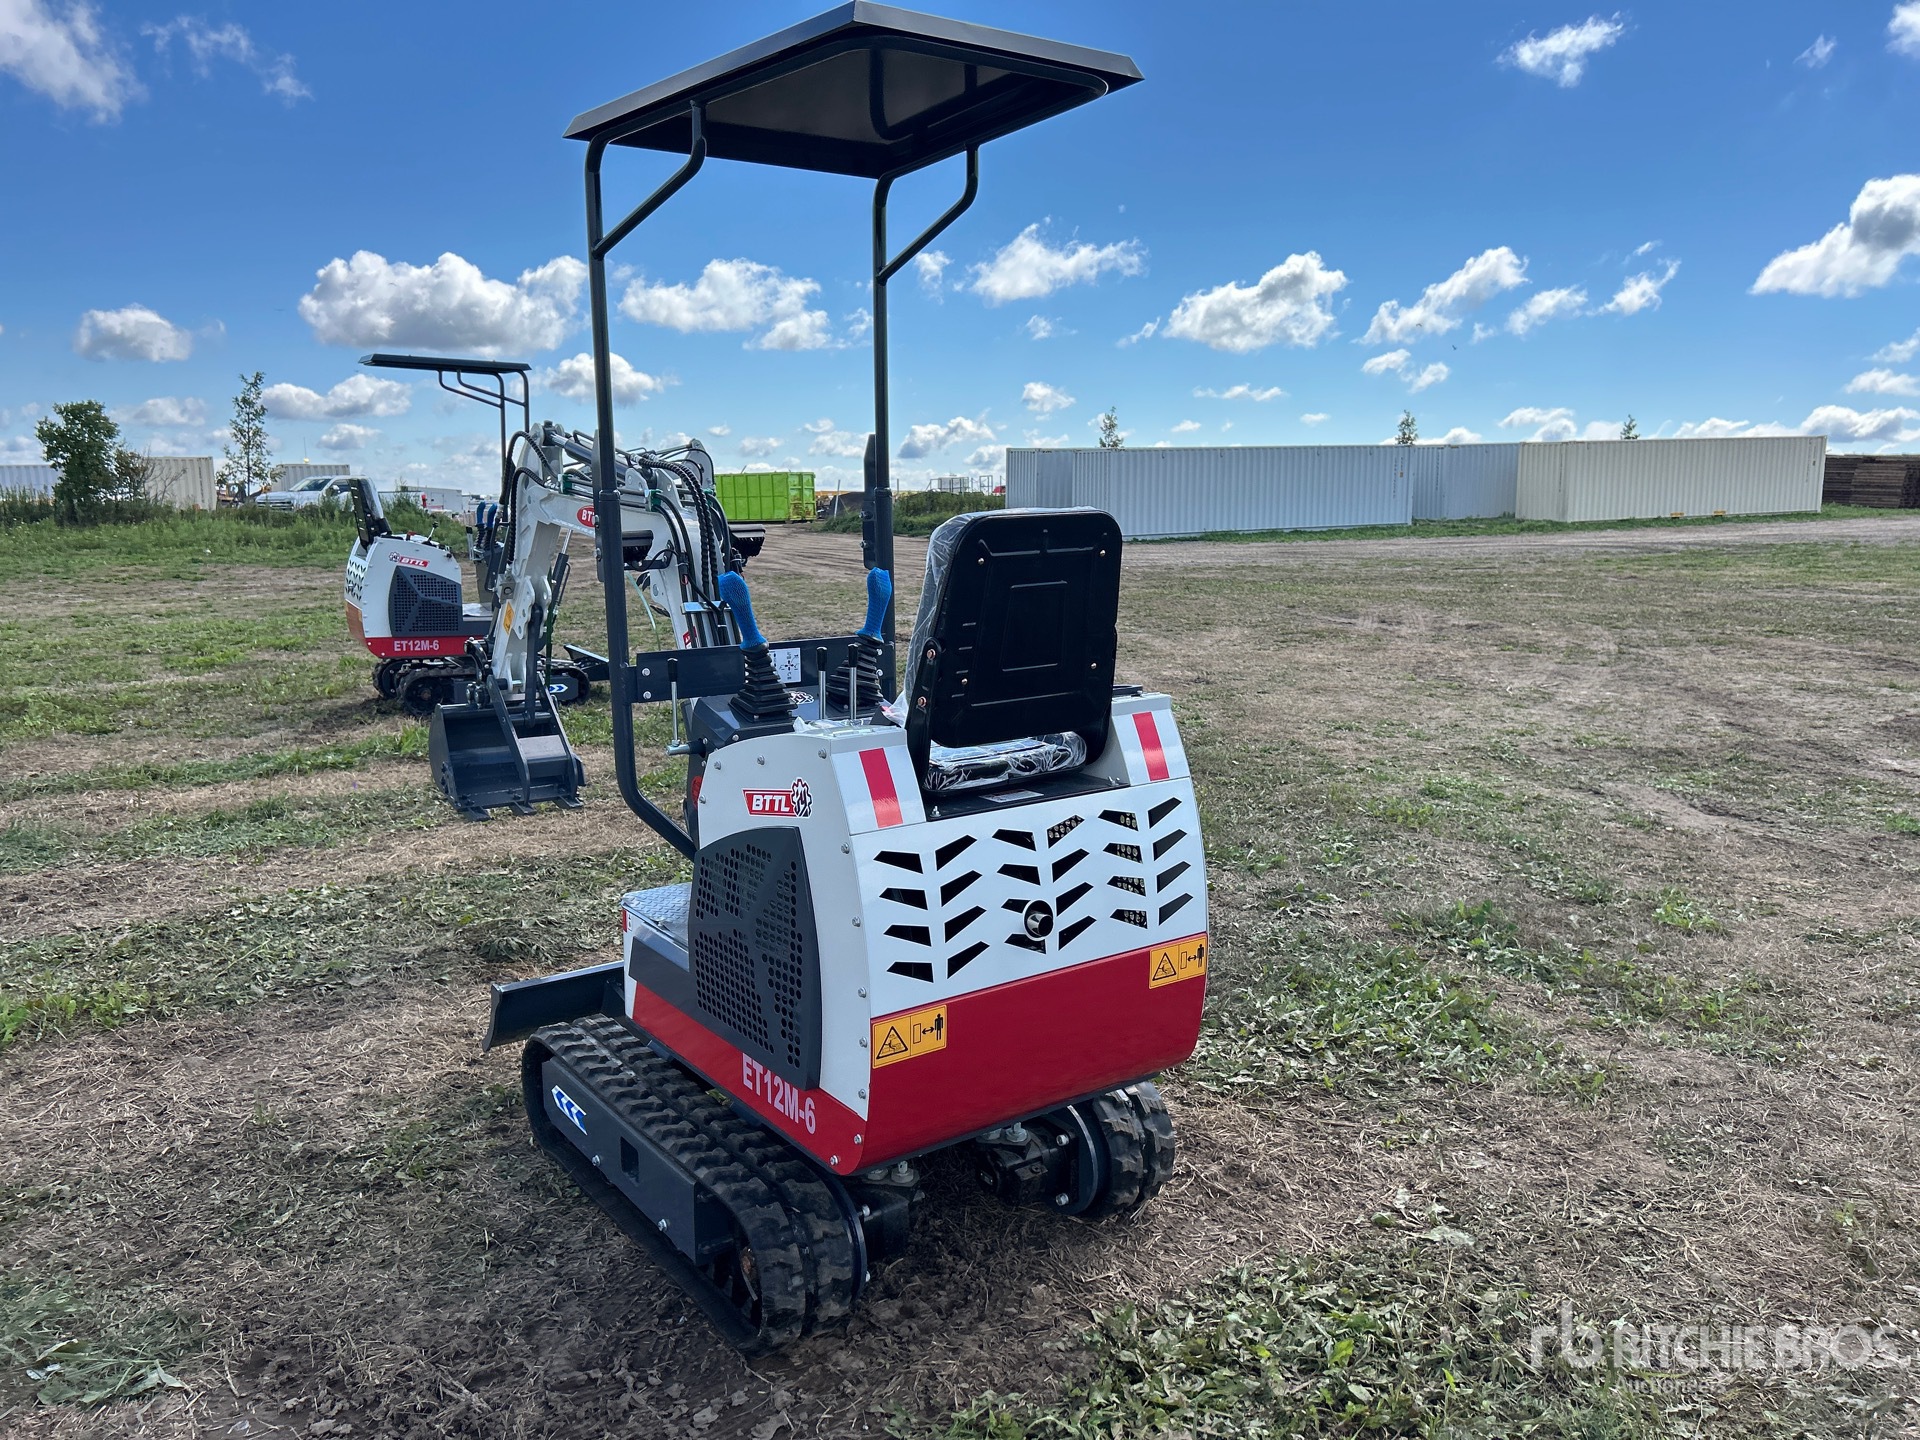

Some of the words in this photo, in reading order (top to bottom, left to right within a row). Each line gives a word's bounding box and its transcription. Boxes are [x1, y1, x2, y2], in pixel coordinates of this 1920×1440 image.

[581, 509, 595, 522] BT
[401, 557, 426, 567] BTTL
[394, 639, 440, 652] ET12M-6
[751, 794, 791, 812] BTTL
[742, 1052, 816, 1135] ET12M-6
